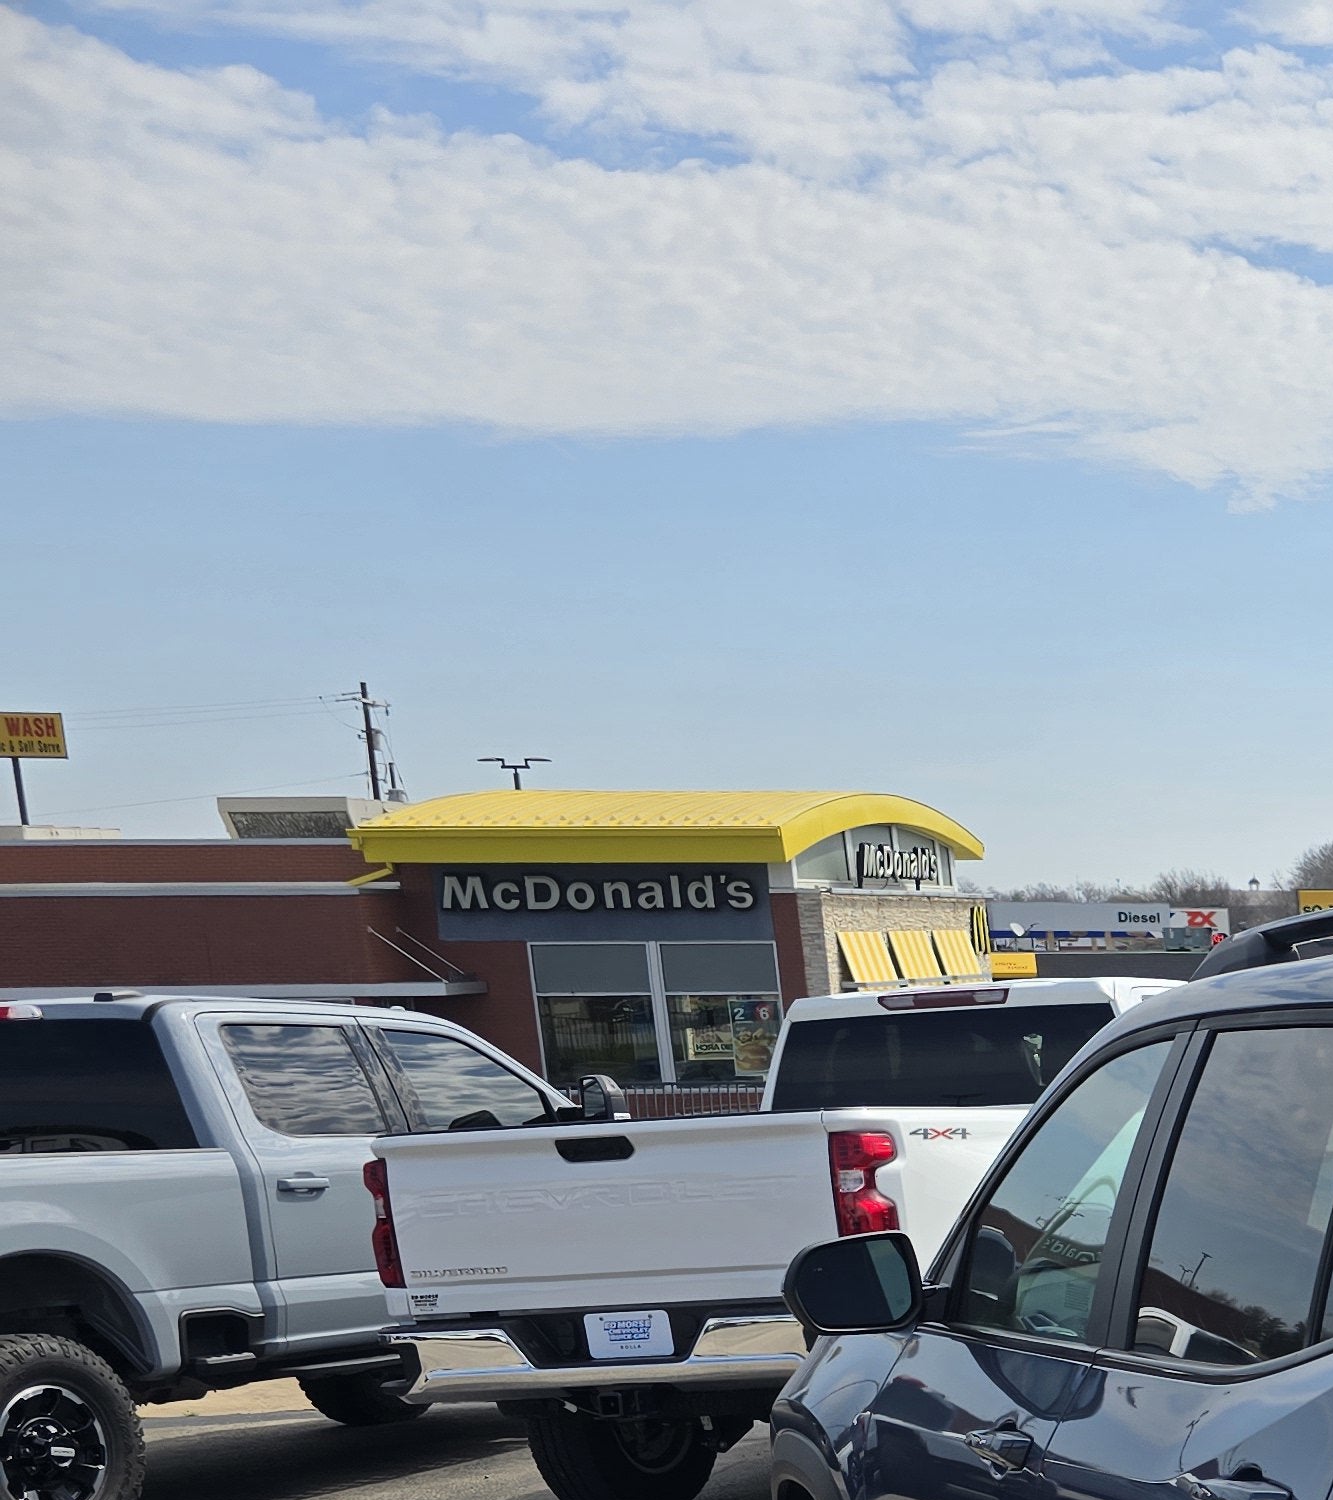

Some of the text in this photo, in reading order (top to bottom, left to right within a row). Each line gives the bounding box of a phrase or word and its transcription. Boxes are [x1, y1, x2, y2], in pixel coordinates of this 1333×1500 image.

[4, 717, 57, 738] WASH
[18, 740, 34, 753] Self
[38, 740, 61, 753] Serve
[862, 844, 937, 880] McDonald's
[441, 874, 755, 911] McDonald's
[1118, 911, 1161, 923] Diesel
[410, 1266, 509, 1279] SILVERADO
[604, 1319, 652, 1331] ED MORSE
